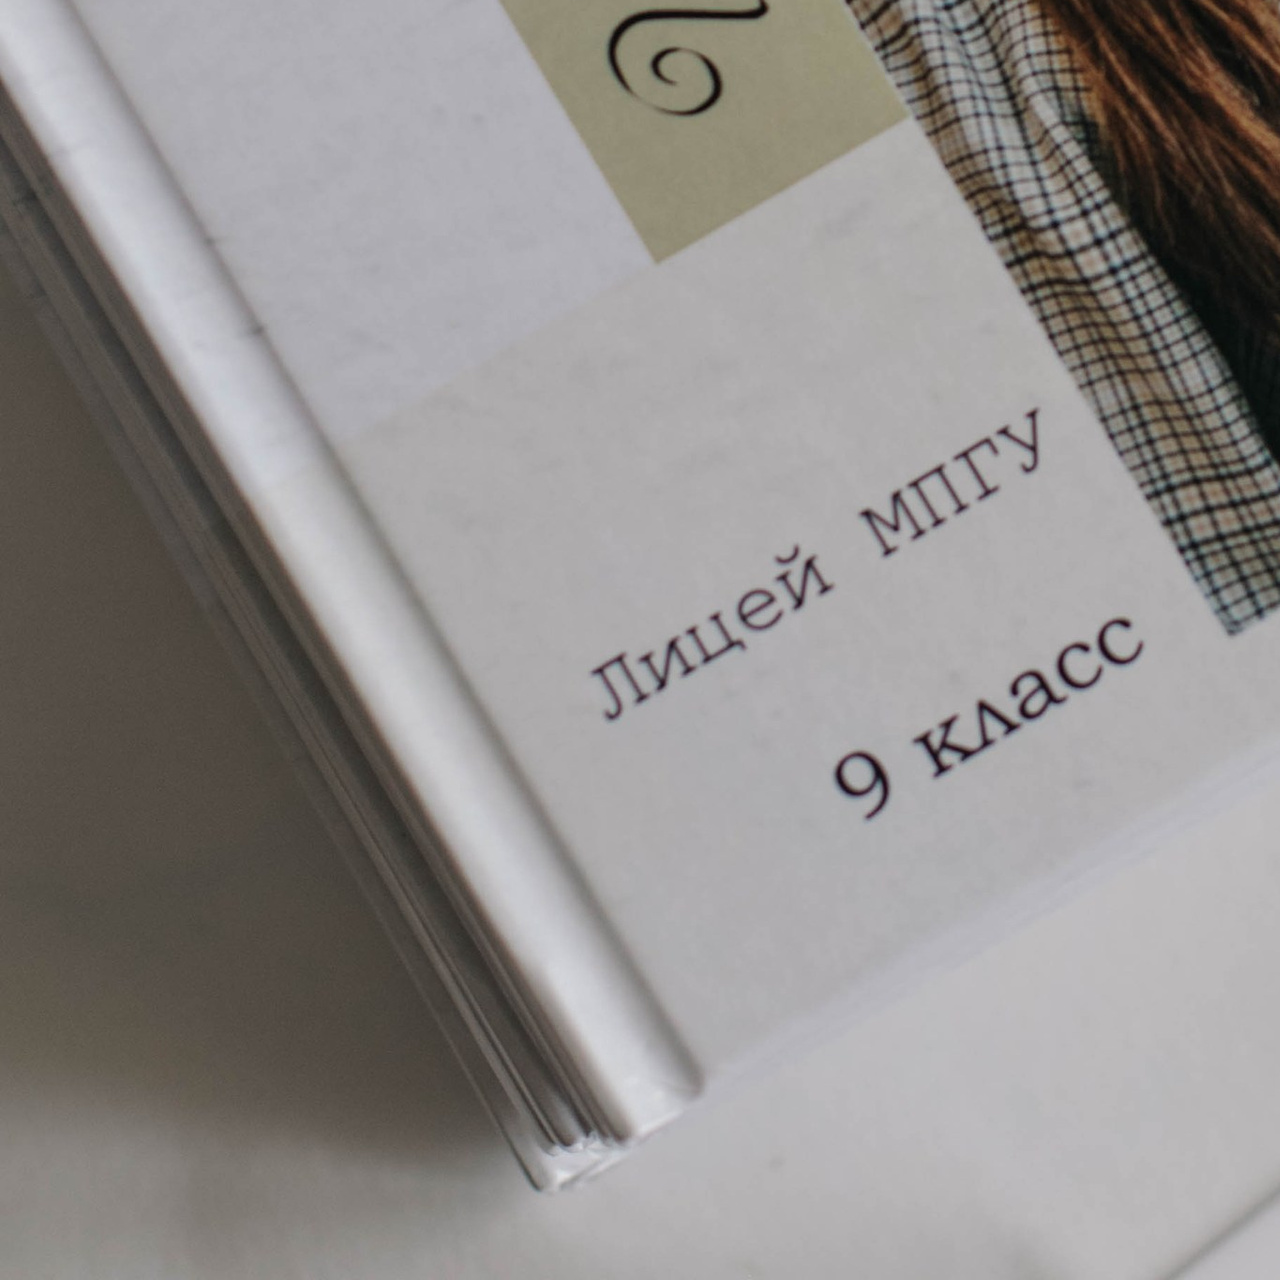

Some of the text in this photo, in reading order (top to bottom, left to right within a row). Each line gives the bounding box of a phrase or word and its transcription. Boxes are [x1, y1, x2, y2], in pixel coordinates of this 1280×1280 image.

[592, 408, 1041, 721] Лицей МПГУ
[834, 617, 1144, 821] 9 класс
